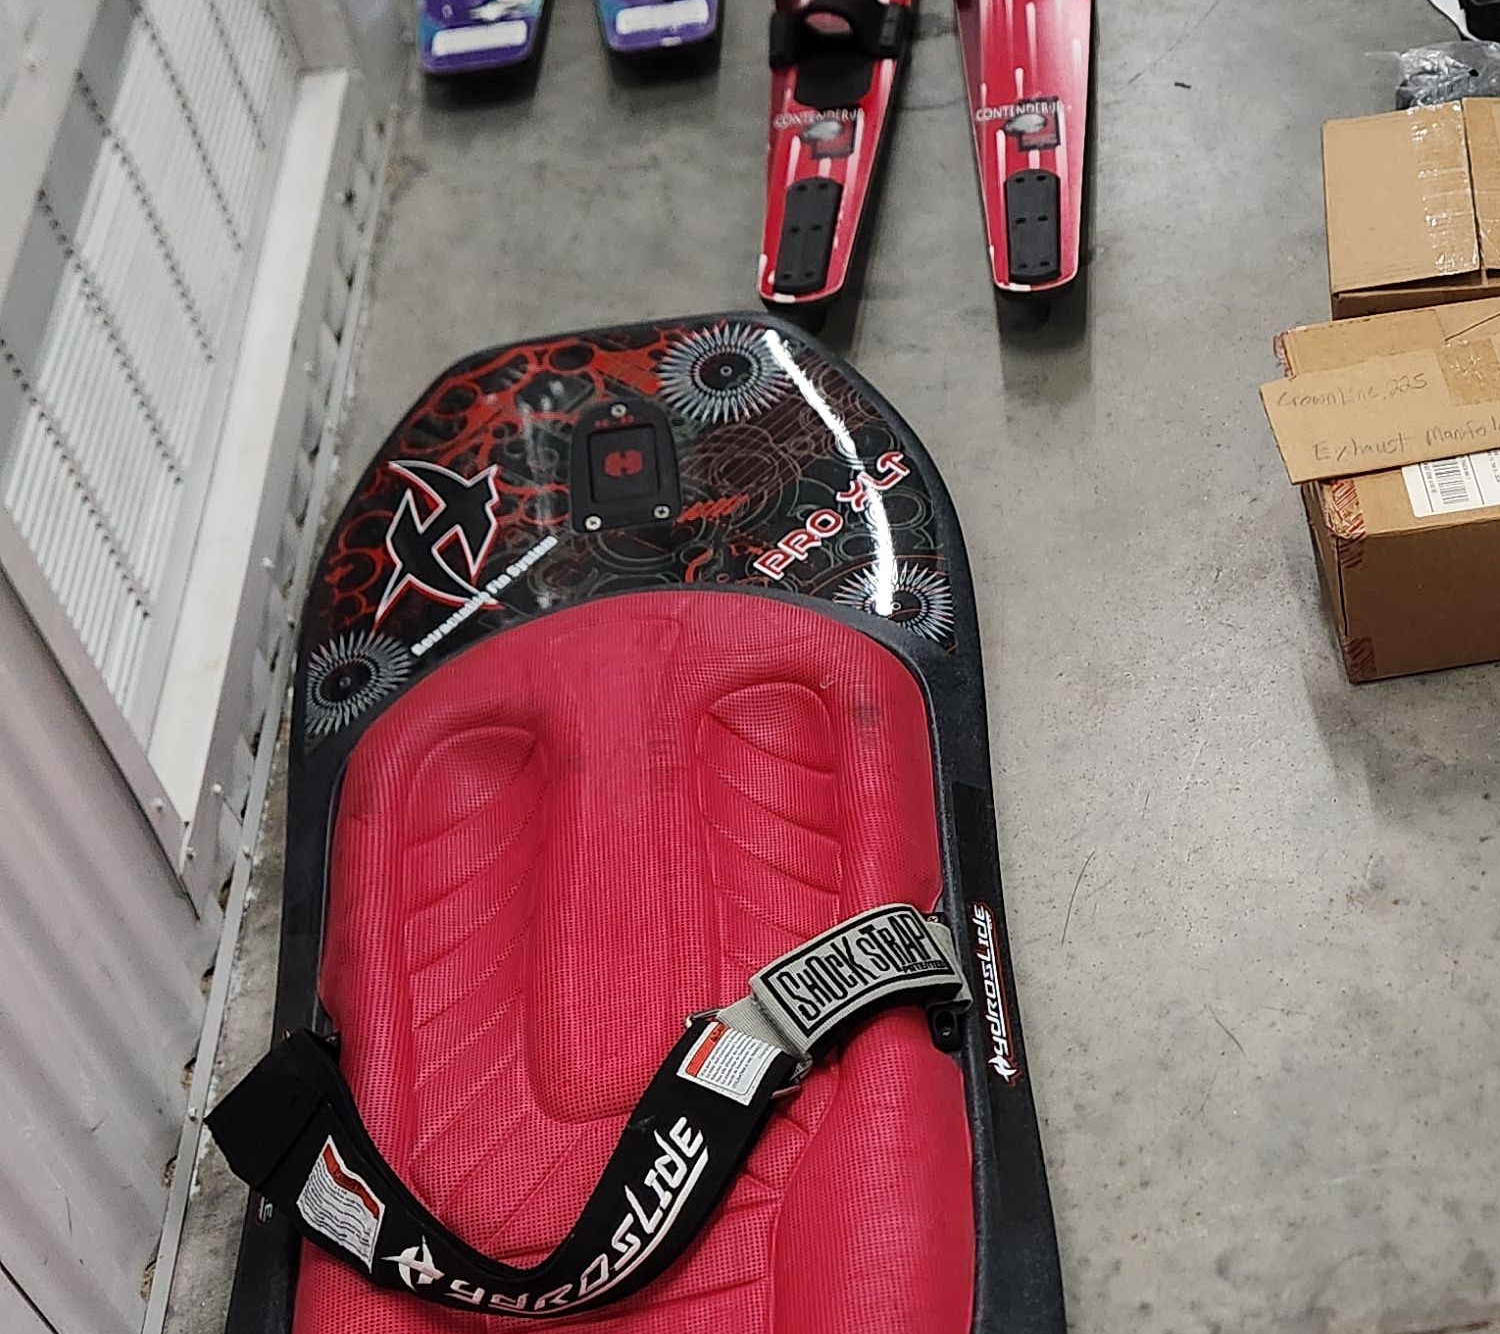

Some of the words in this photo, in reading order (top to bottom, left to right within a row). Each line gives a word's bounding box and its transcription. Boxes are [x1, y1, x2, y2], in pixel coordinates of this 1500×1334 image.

[1312, 432, 1416, 461] Exhaust
[485, 573, 512, 595] Fin
[506, 535, 559, 578] System
[753, 508, 844, 580] PRO
[776, 935, 882, 1021] SHOCK
[856, 913, 932, 973] STRAP
